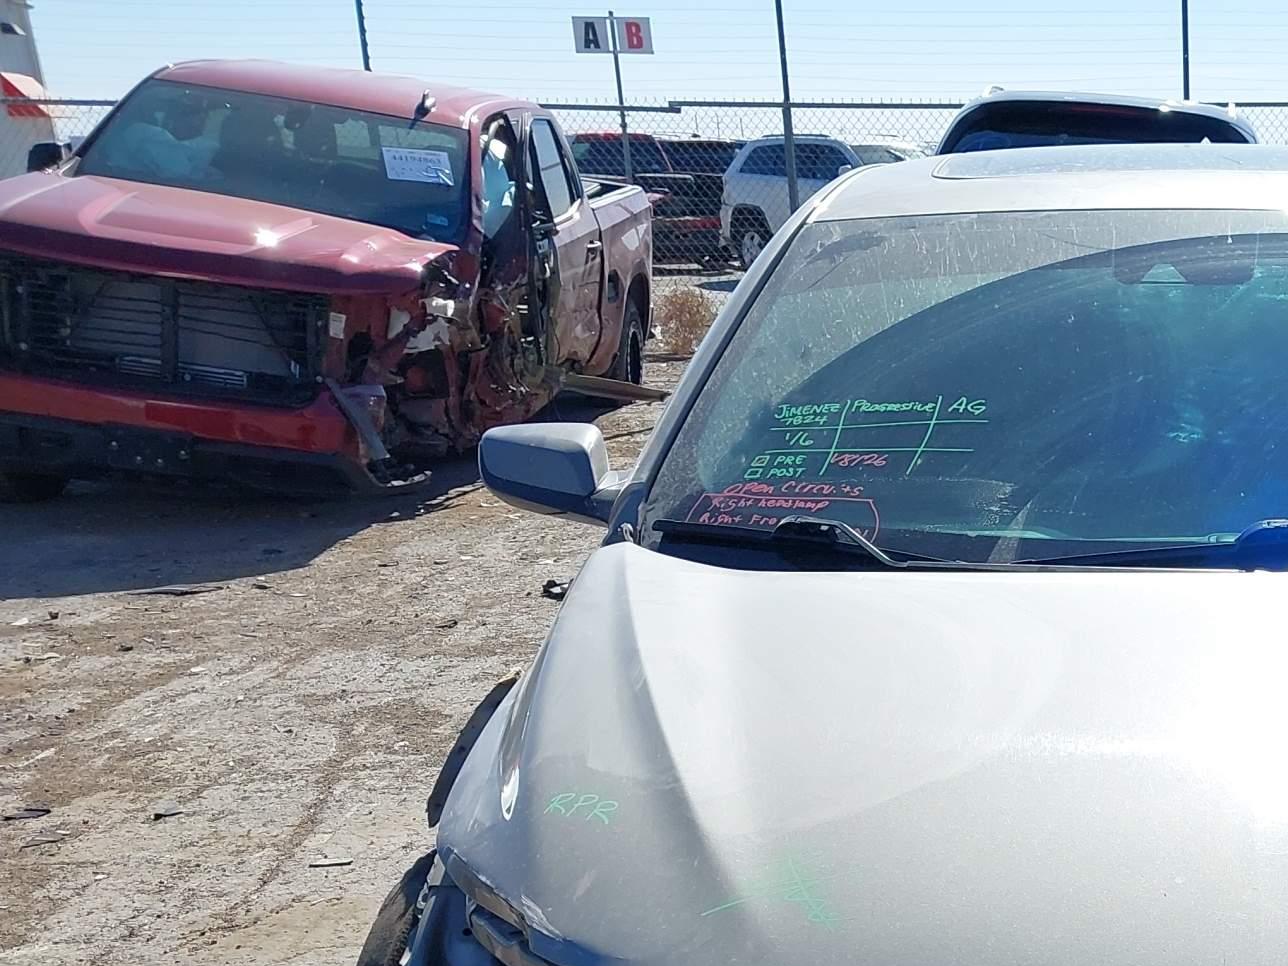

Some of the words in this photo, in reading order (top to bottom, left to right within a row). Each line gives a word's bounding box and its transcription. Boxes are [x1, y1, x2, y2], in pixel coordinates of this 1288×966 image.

[584, 21, 601, 49] A
[625, 21, 644, 49] B
[948, 397, 987, 415] AG
[774, 455, 808, 466] PRE
[767, 467, 807, 478] POST
[544, 792, 618, 825] RPR
